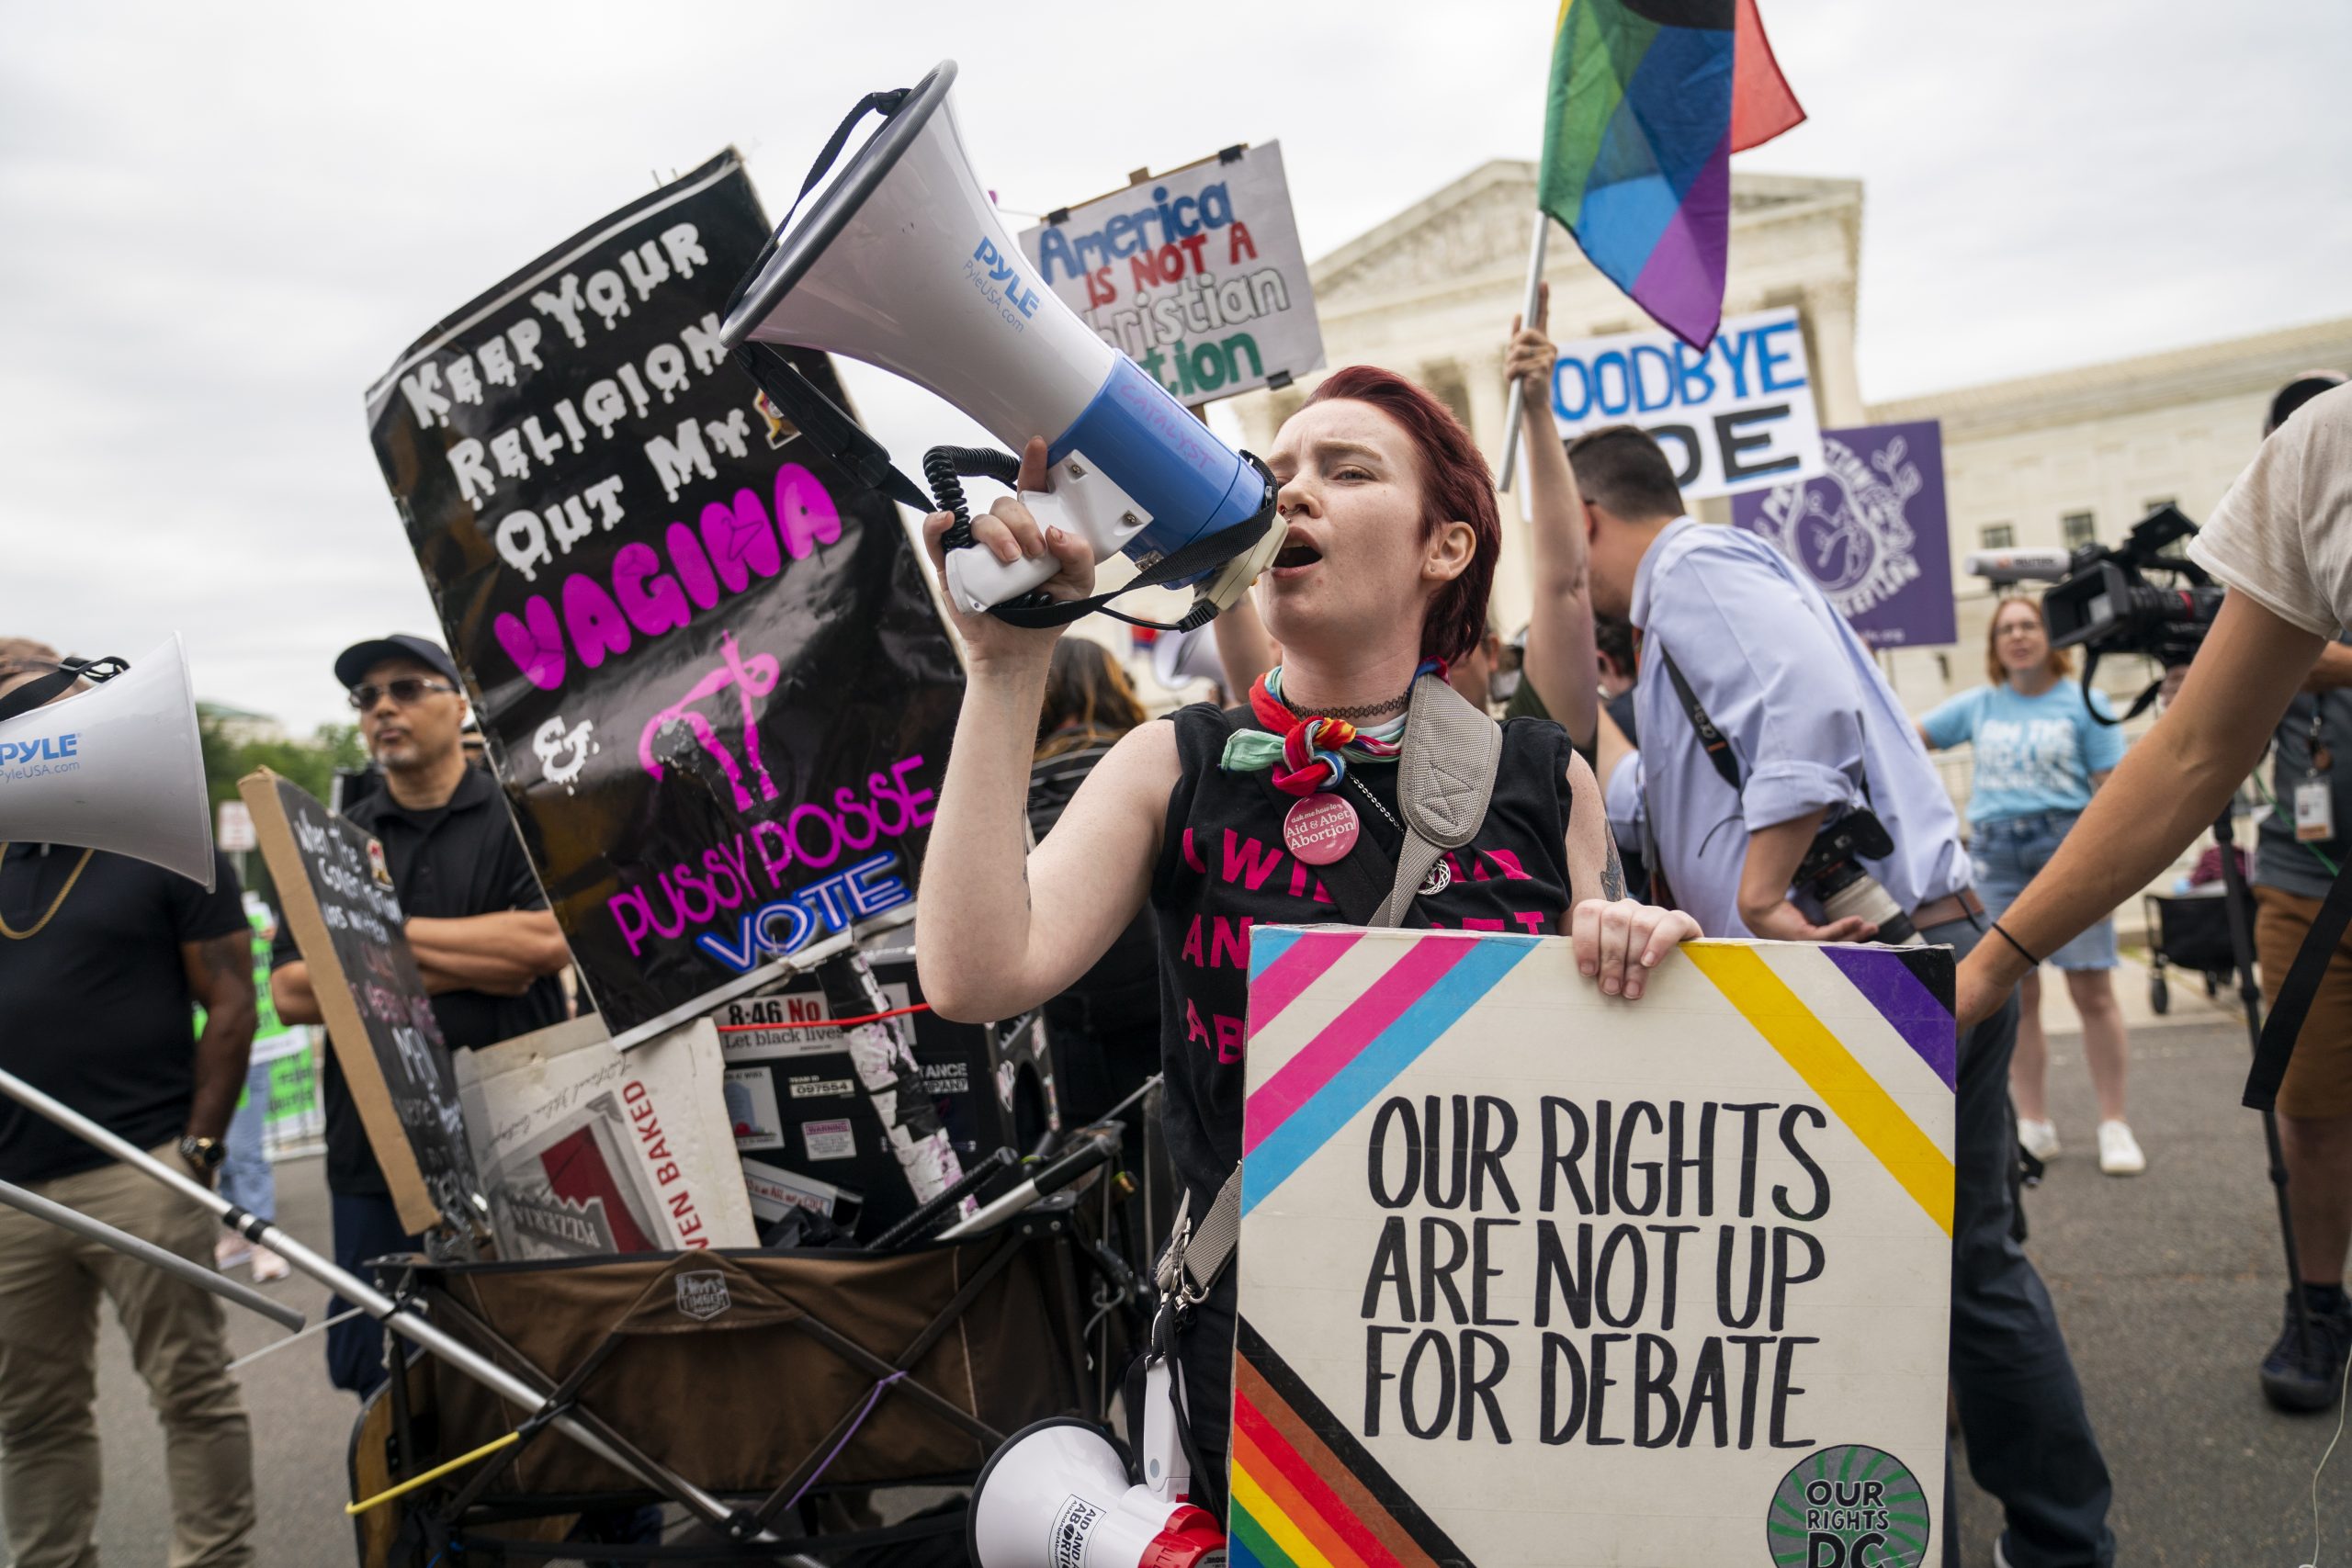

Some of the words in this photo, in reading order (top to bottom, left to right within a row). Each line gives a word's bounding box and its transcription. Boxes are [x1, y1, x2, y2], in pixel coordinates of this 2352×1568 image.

[1039, 181, 1236, 286] America
[1084, 266, 1117, 309] IS
[1130, 233, 1208, 293] NOT
[1229, 220, 1258, 265] A
[973, 235, 1041, 320] PYLE
[1083, 267, 1291, 355] hristian
[401, 319, 542, 429] KEEP
[531, 222, 707, 348] YOUR
[1139, 333, 1264, 397] tion
[1552, 320, 1809, 421] OODBYE
[446, 312, 728, 512] RELIGION
[1119, 384, 1216, 470] CATALYST
[494, 475, 625, 581] OUT
[644, 408, 751, 502] MY
[494, 462, 843, 691] VAGINA
[533, 716, 600, 795] &
[1286, 822, 1309, 839] Aid
[1309, 820, 1318, 829] &
[1320, 809, 1352, 827] Abet
[1290, 821, 1355, 851] Abortion
[1291, 814, 1306, 823] ask
[1305, 811, 1316, 819] me
[1316, 806, 1330, 816] how
[608, 833, 753, 957] PUSSY
[752, 755, 937, 889] POSSE
[696, 851, 913, 974] VOTE
[1182, 912, 1252, 970] AN
[724, 1030, 751, 1050] Let
[755, 1028, 801, 1046] black
[787, 998, 822, 1023] No
[1187, 998, 1244, 1065] AB
[919, 1063, 968, 1079] TANCE
[623, 1079, 681, 1187] BAKED
[1368, 1094, 1521, 1214] OUR
[1539, 1094, 1831, 1222] RIGHTS
[668, 1190, 710, 1250] VEN
[1361, 1215, 1521, 1325] ARE
[1533, 1219, 1701, 1331] NOT
[1716, 1224, 1826, 1332] UP
[1363, 1325, 1513, 1445] FOR
[1539, 1332, 1820, 1450] DEBATE
[1080, 1508, 1097, 1531] AID
[1805, 1479, 1886, 1508] OUR
[1806, 1507, 1891, 1531] RIGHTS
[1071, 1531, 1085, 1561] AND
[1807, 1531, 1888, 1568] DC
